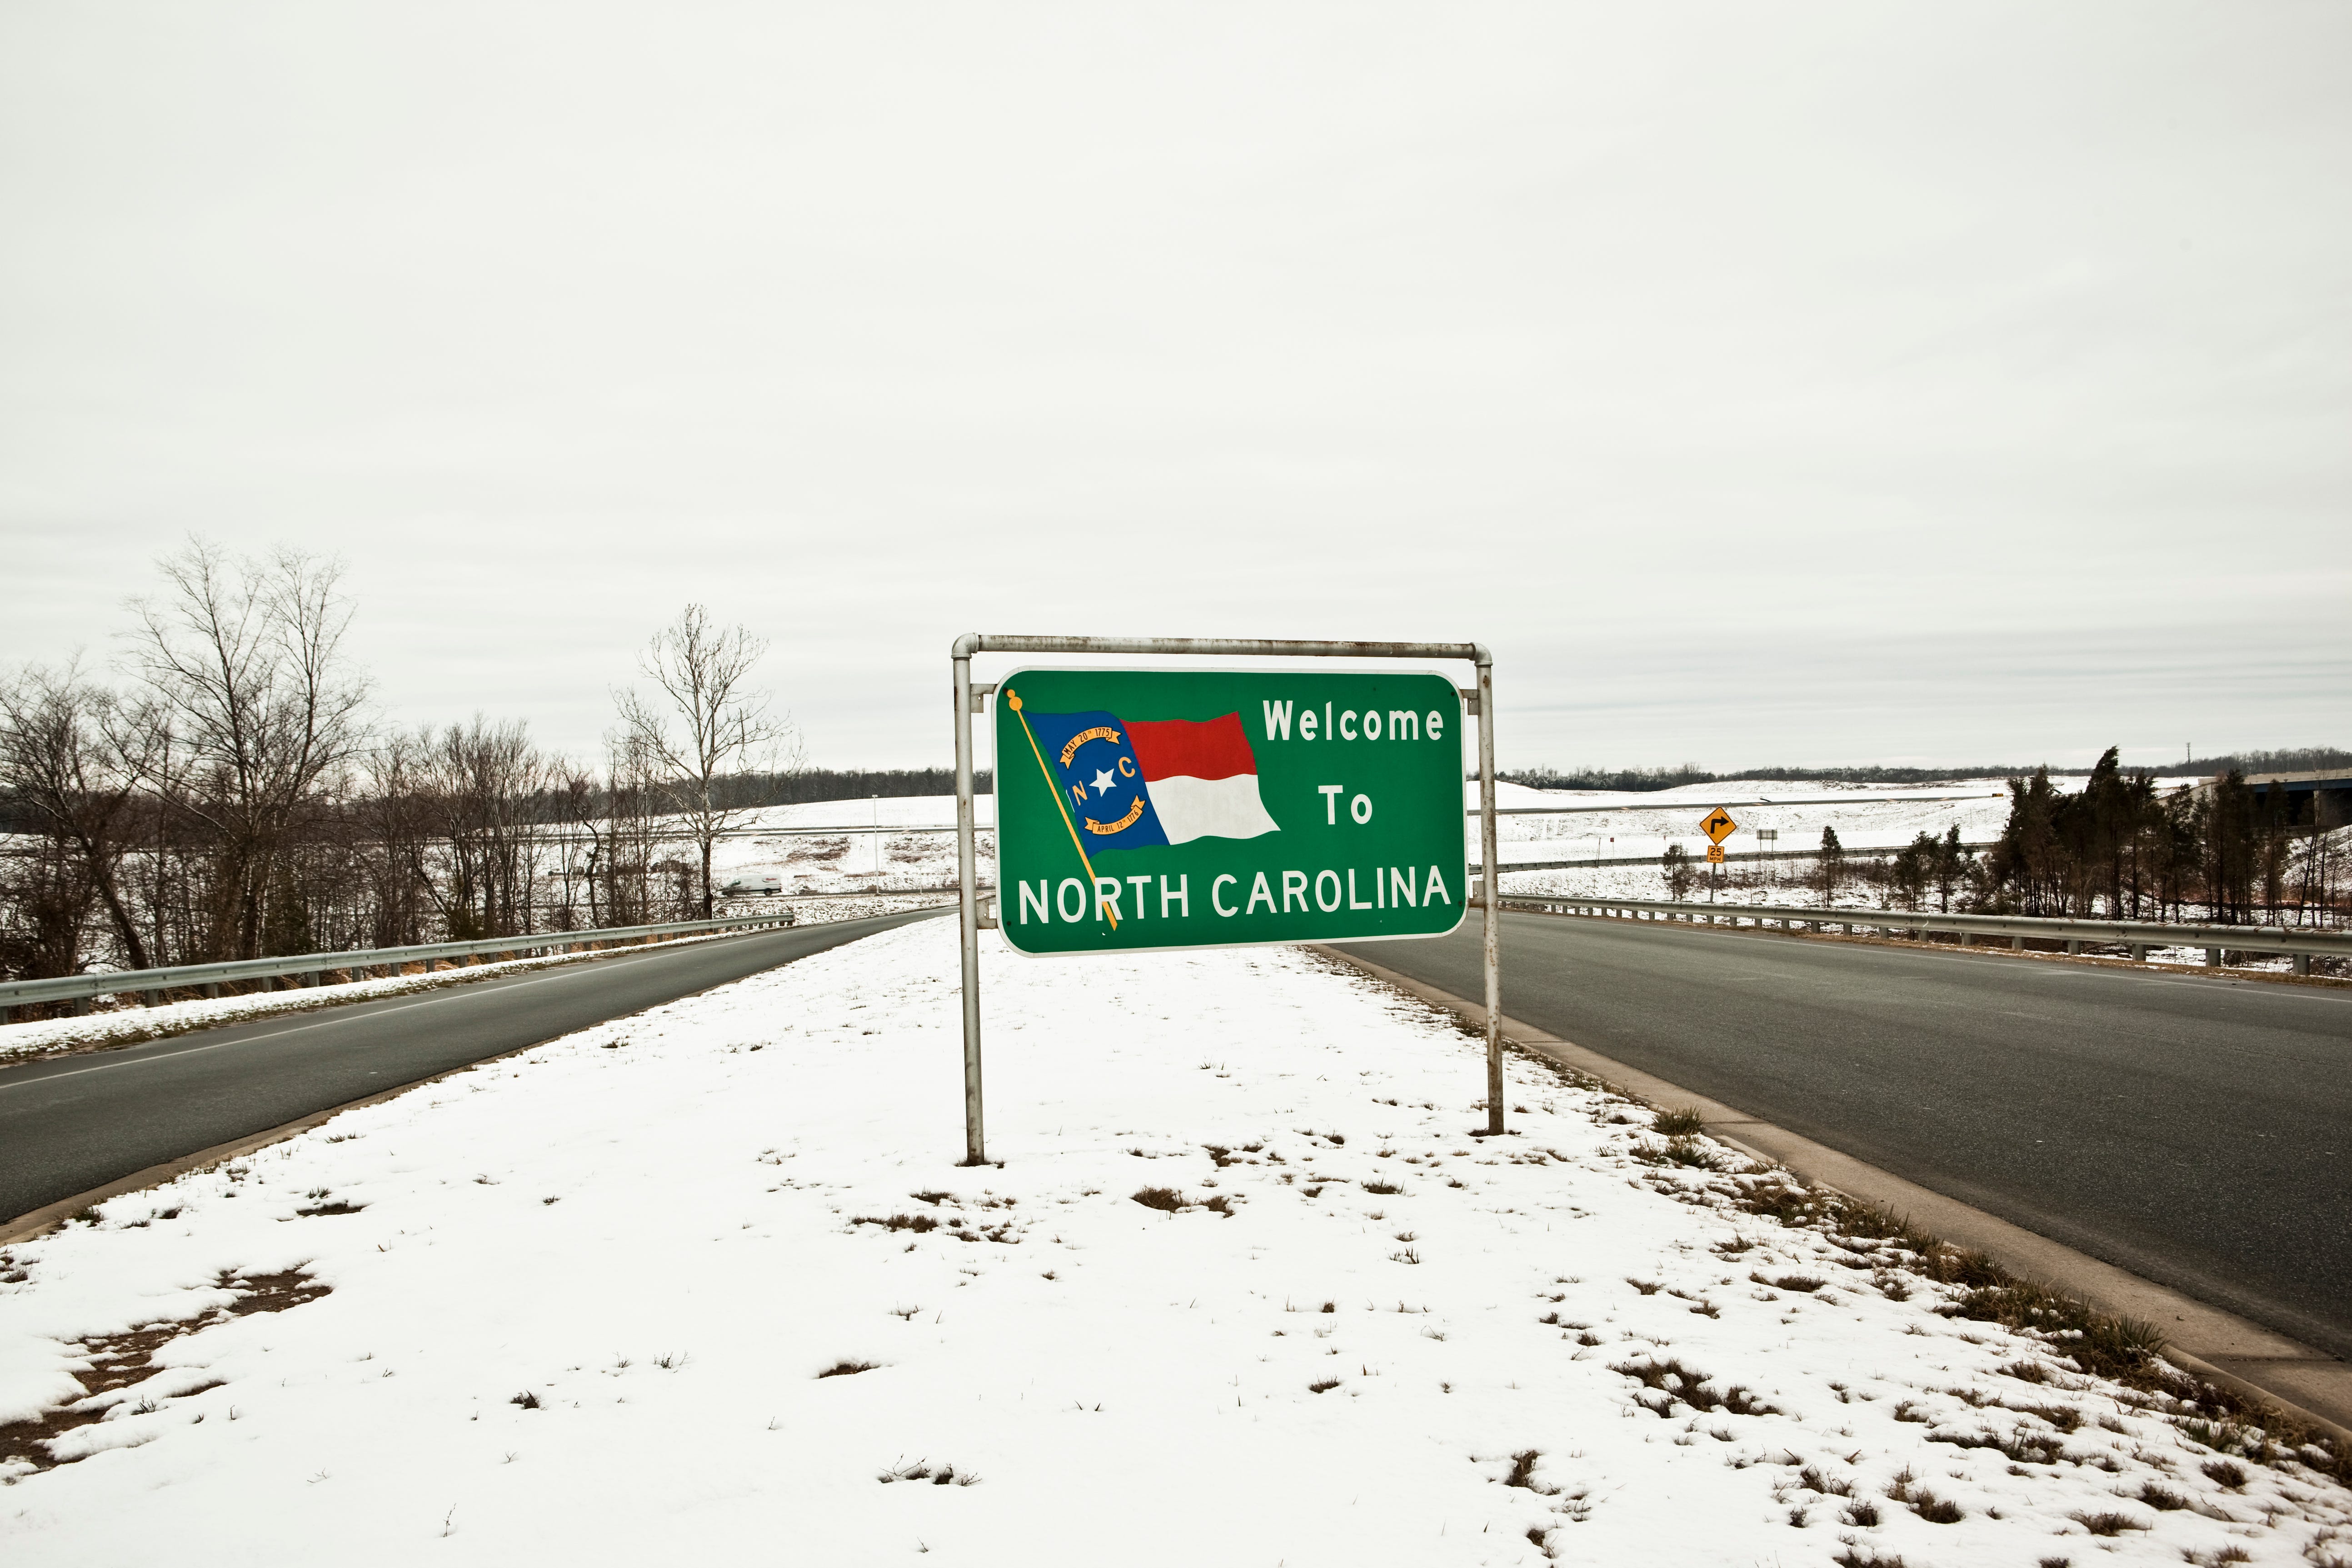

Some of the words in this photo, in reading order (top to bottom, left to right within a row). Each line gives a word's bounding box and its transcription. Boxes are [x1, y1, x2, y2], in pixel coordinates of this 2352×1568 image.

[1263, 700, 1443, 741] Welcome
[1064, 740, 1077, 755] MAY
[1095, 728, 1109, 737] 1775
[1072, 780, 1088, 806] N
[1118, 756, 1136, 778] C
[1127, 810, 1139, 823] 1776
[1318, 785, 1373, 825] To
[1710, 848, 1721, 856] 25
[1019, 874, 1188, 924] NORTH
[1212, 865, 1452, 917] CAROLINA
